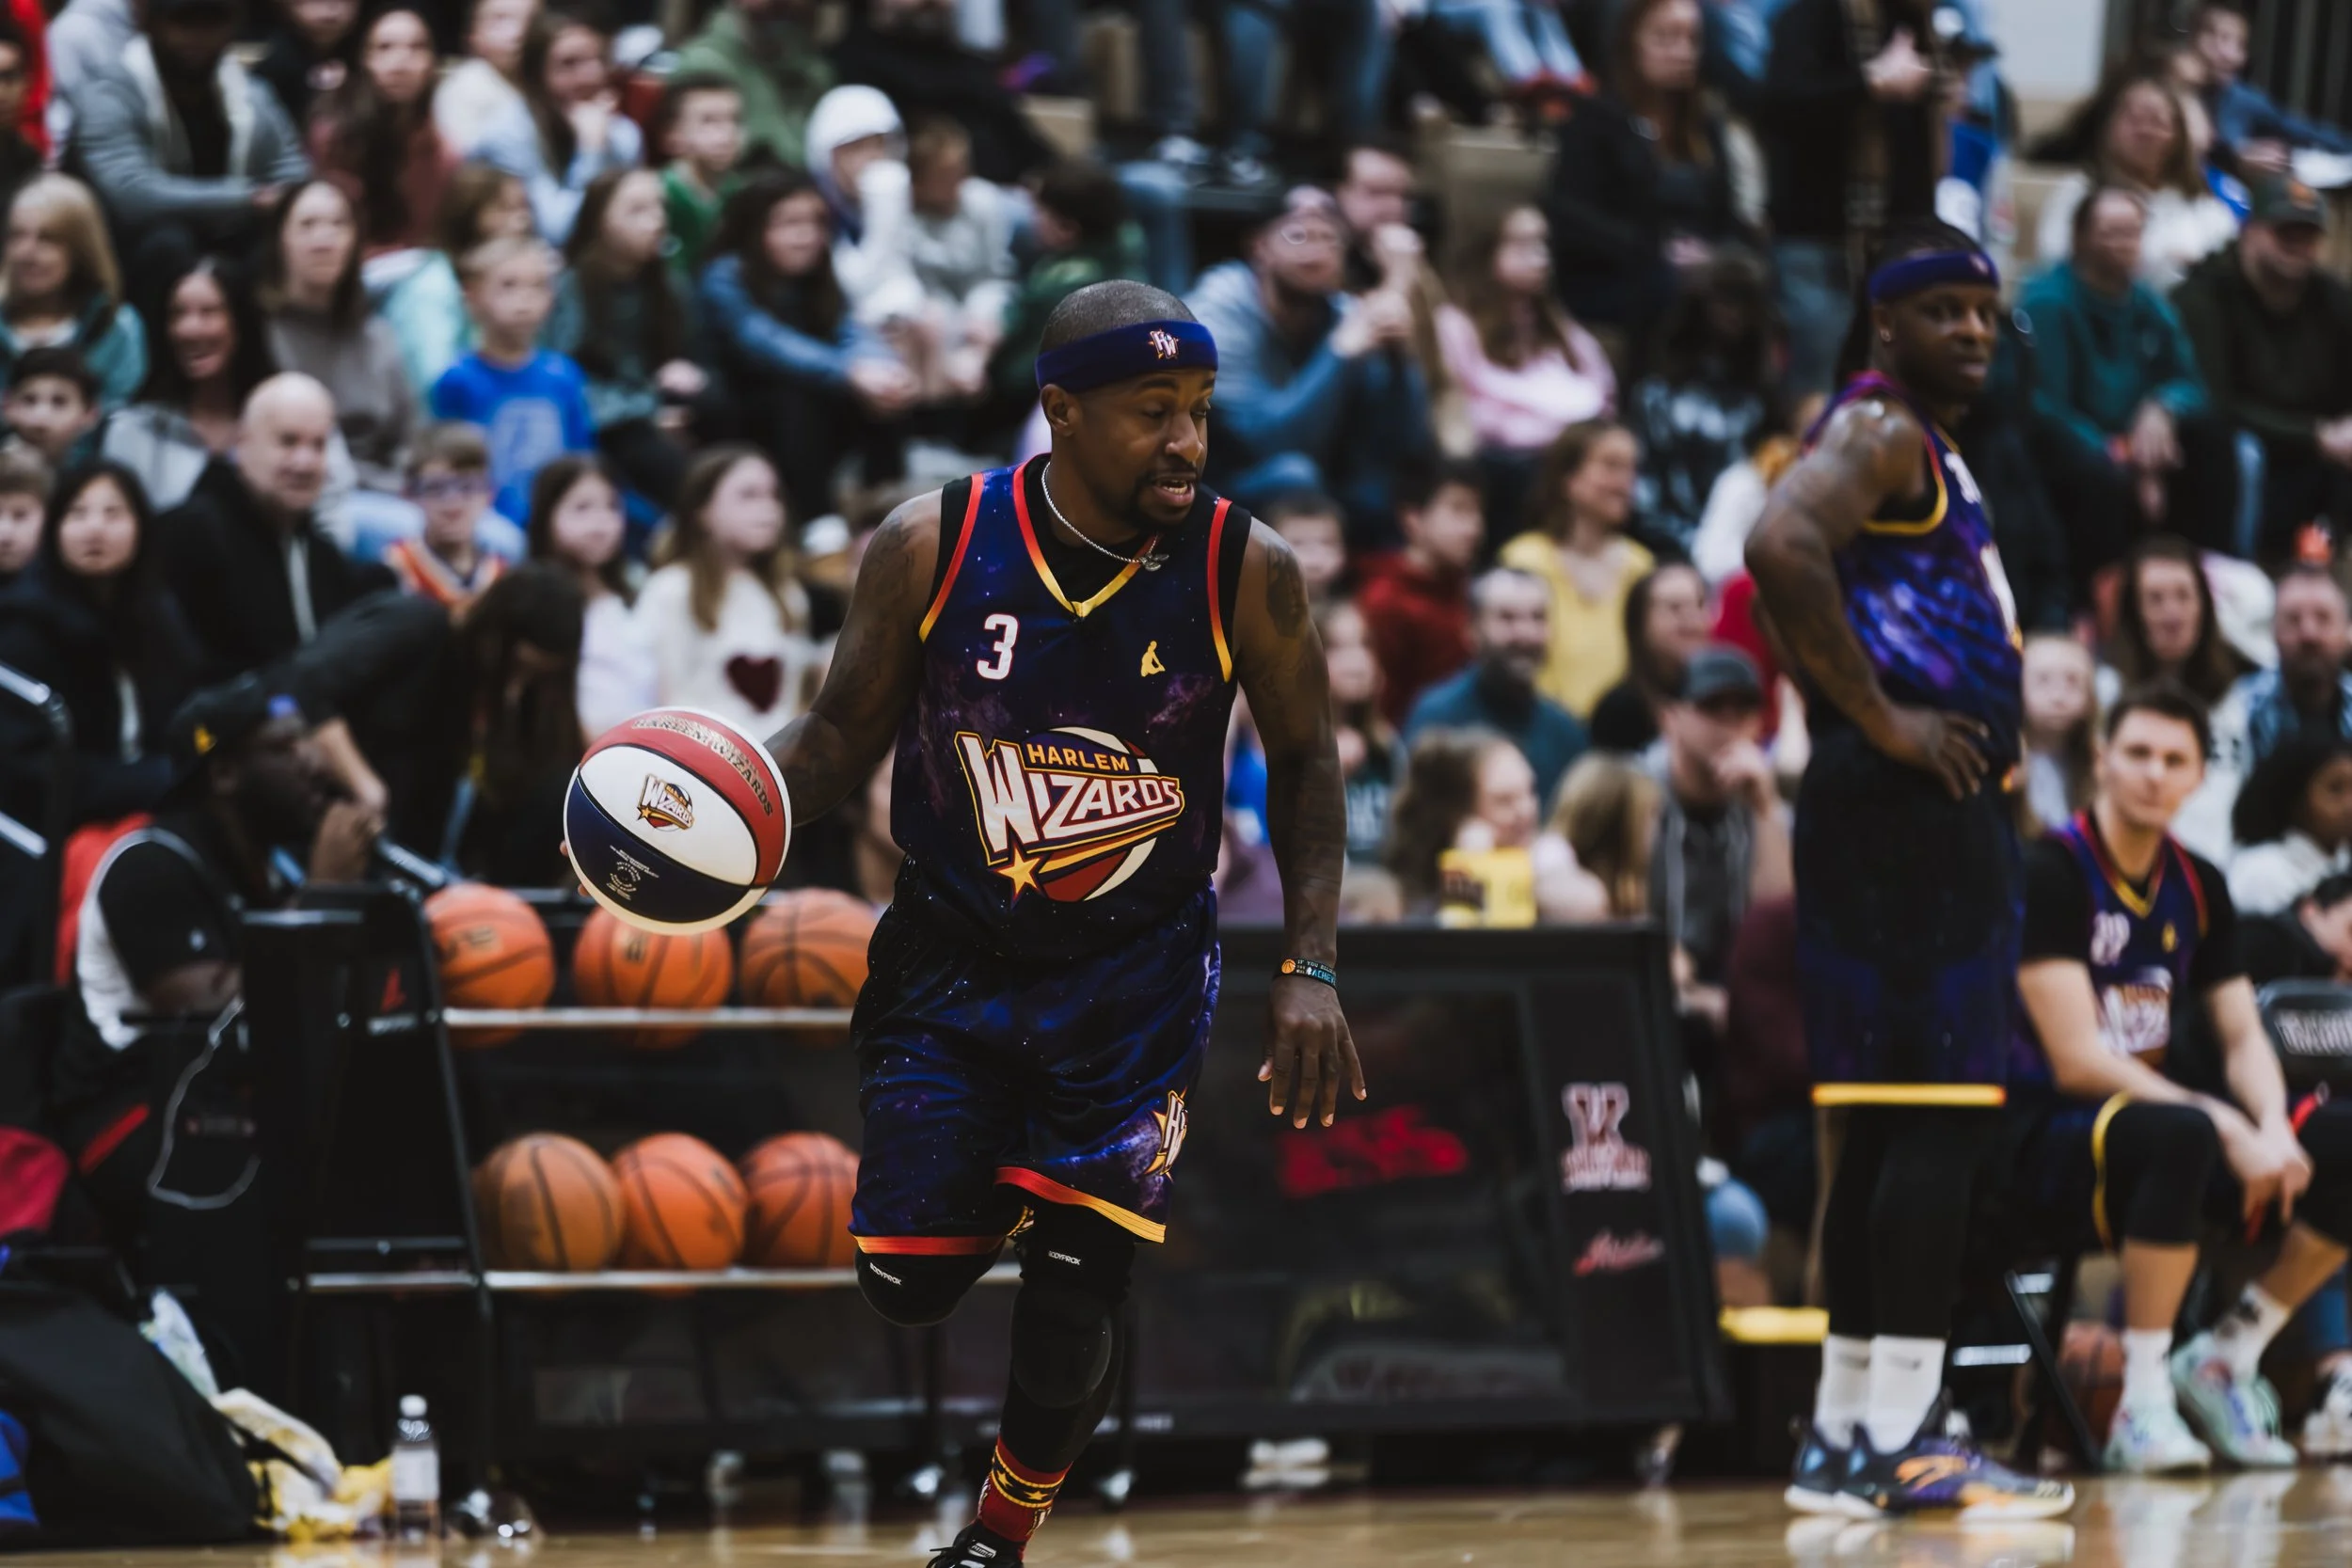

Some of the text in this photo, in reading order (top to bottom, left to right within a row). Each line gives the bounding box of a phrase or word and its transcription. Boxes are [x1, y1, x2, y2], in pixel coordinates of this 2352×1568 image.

[977, 612, 1019, 681] 3
[1026, 742, 1130, 771] HARLEM
[958, 733, 1183, 856] WIZARDS
